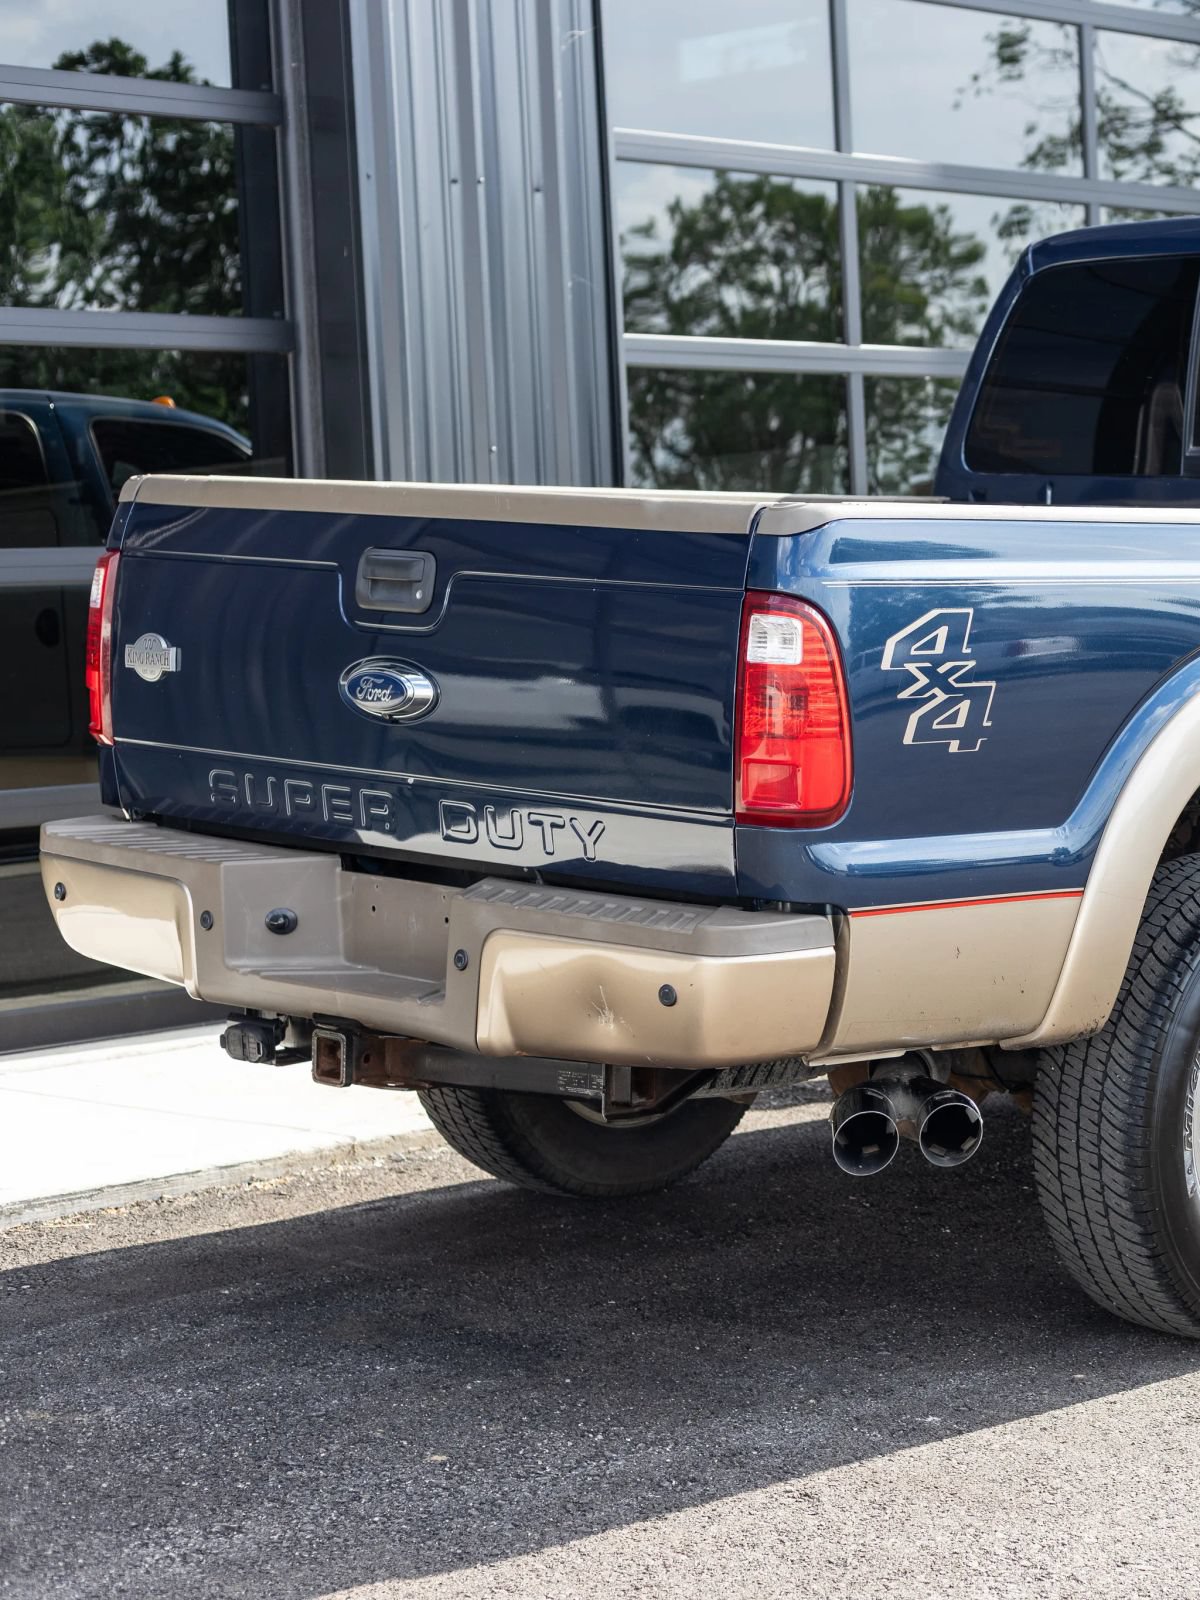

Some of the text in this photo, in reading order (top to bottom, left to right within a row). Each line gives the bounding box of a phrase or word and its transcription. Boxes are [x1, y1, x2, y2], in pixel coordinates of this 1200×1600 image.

[127, 648, 169, 667] KING RANCH
[356, 676, 393, 702] Ford
[207, 768, 607, 863] SUPER DUTY
